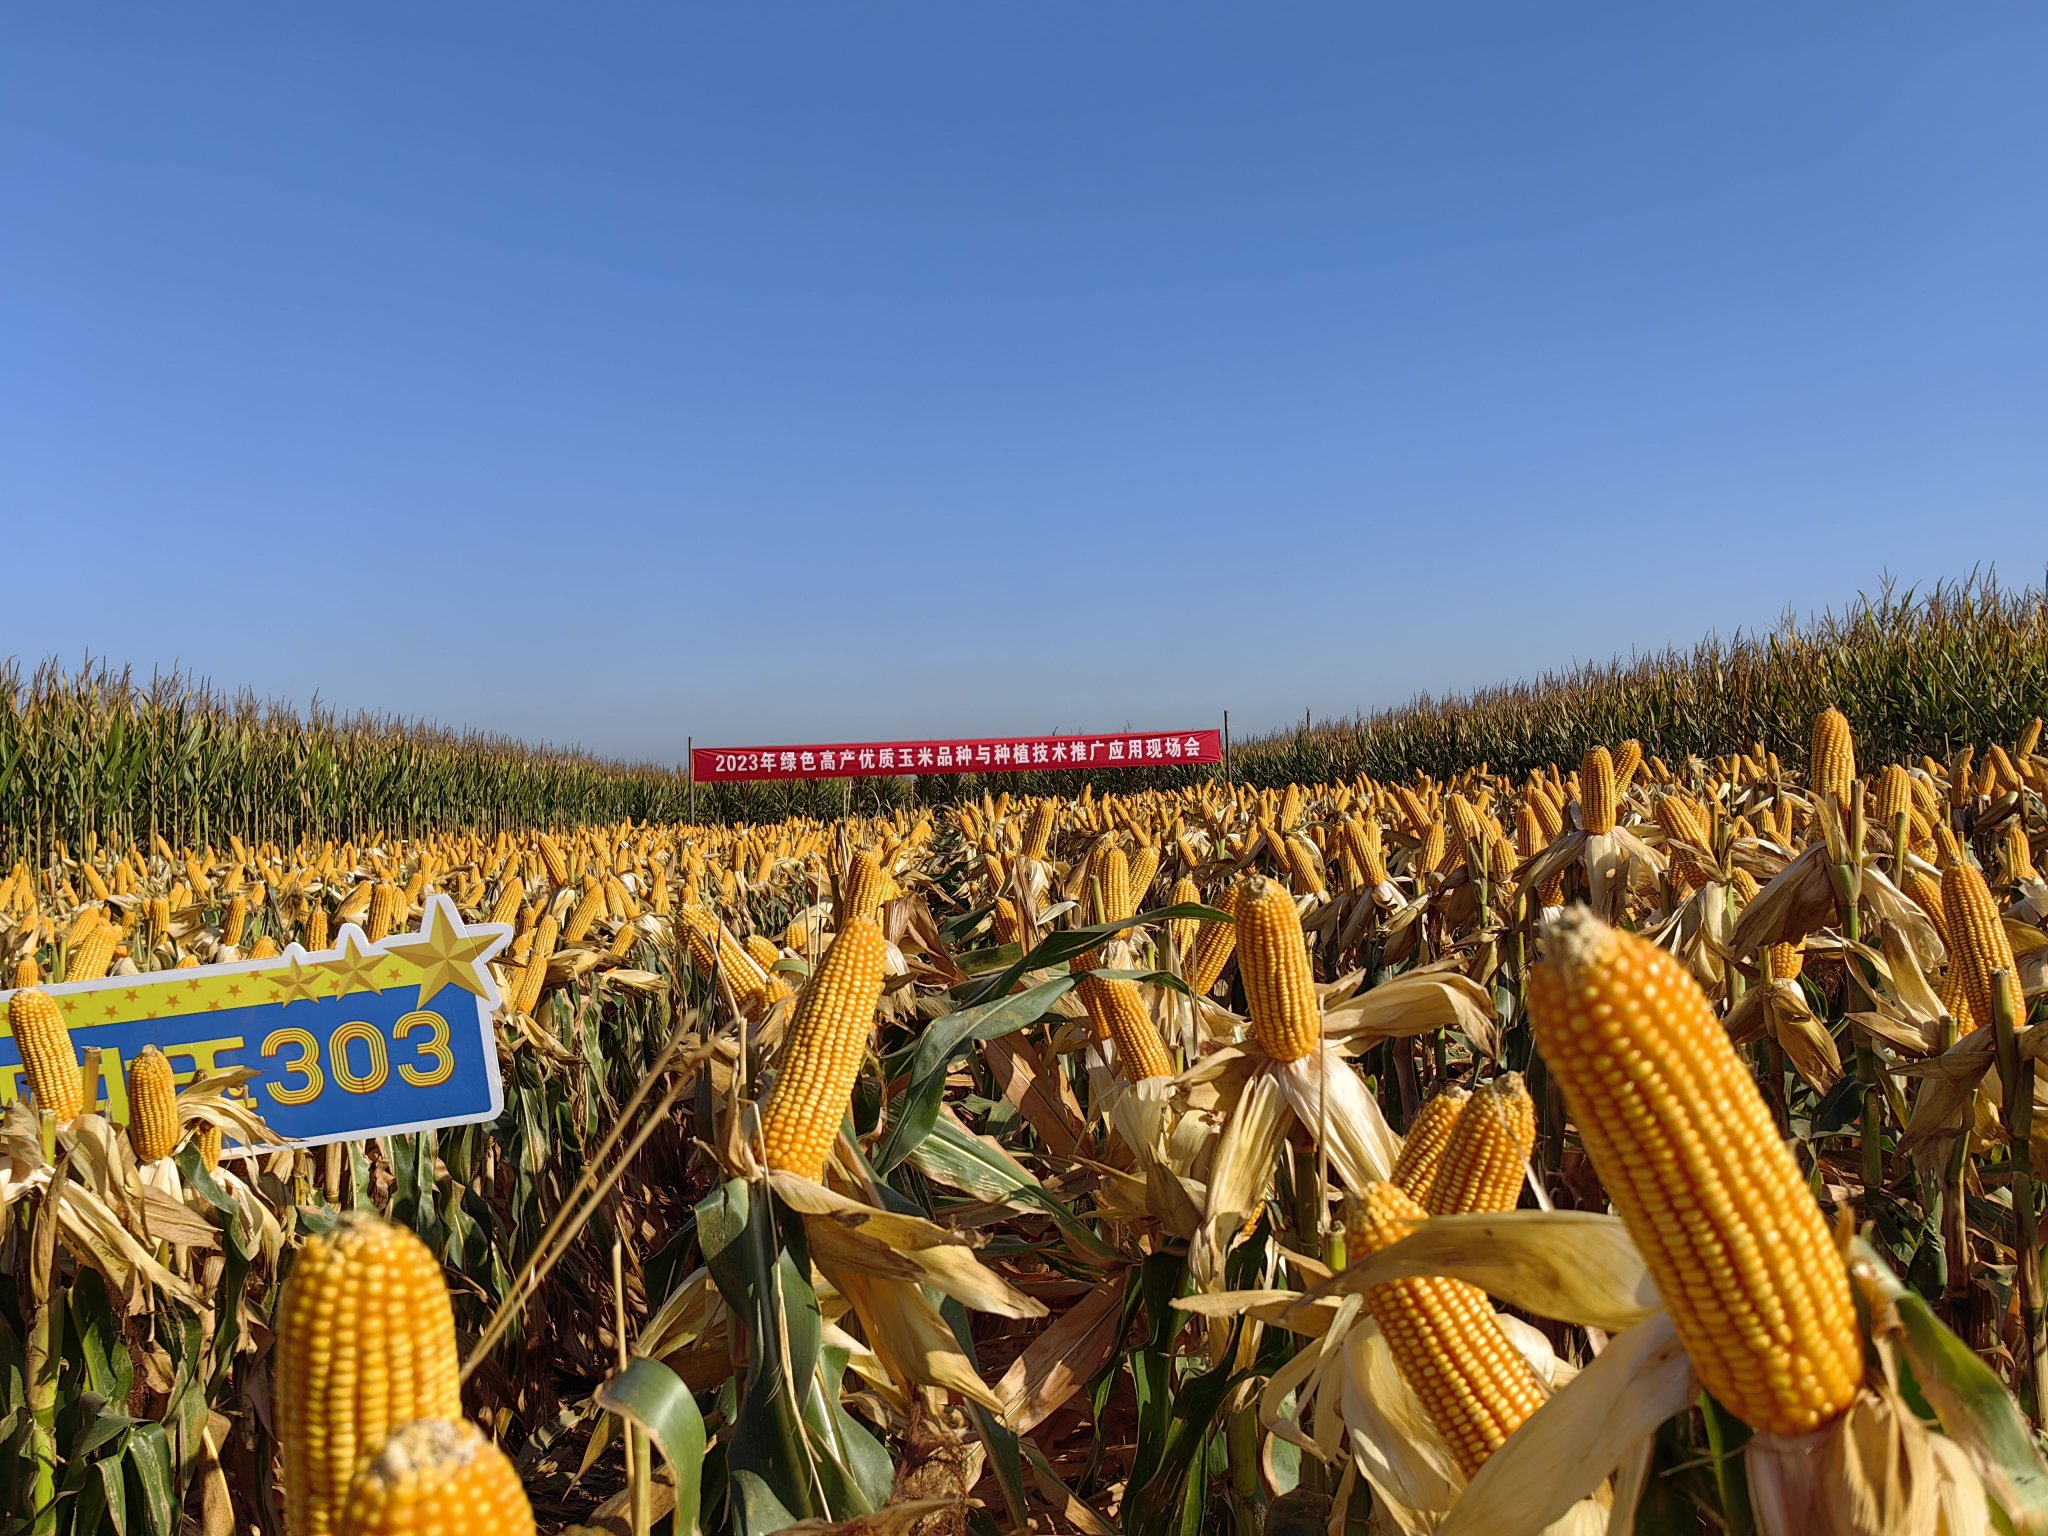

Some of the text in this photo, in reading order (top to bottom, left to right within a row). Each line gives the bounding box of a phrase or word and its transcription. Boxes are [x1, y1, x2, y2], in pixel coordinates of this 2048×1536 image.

[715, 736, 1200, 772] 2023年绿色高产优质玉米品种与种植技术推广应用现场会
